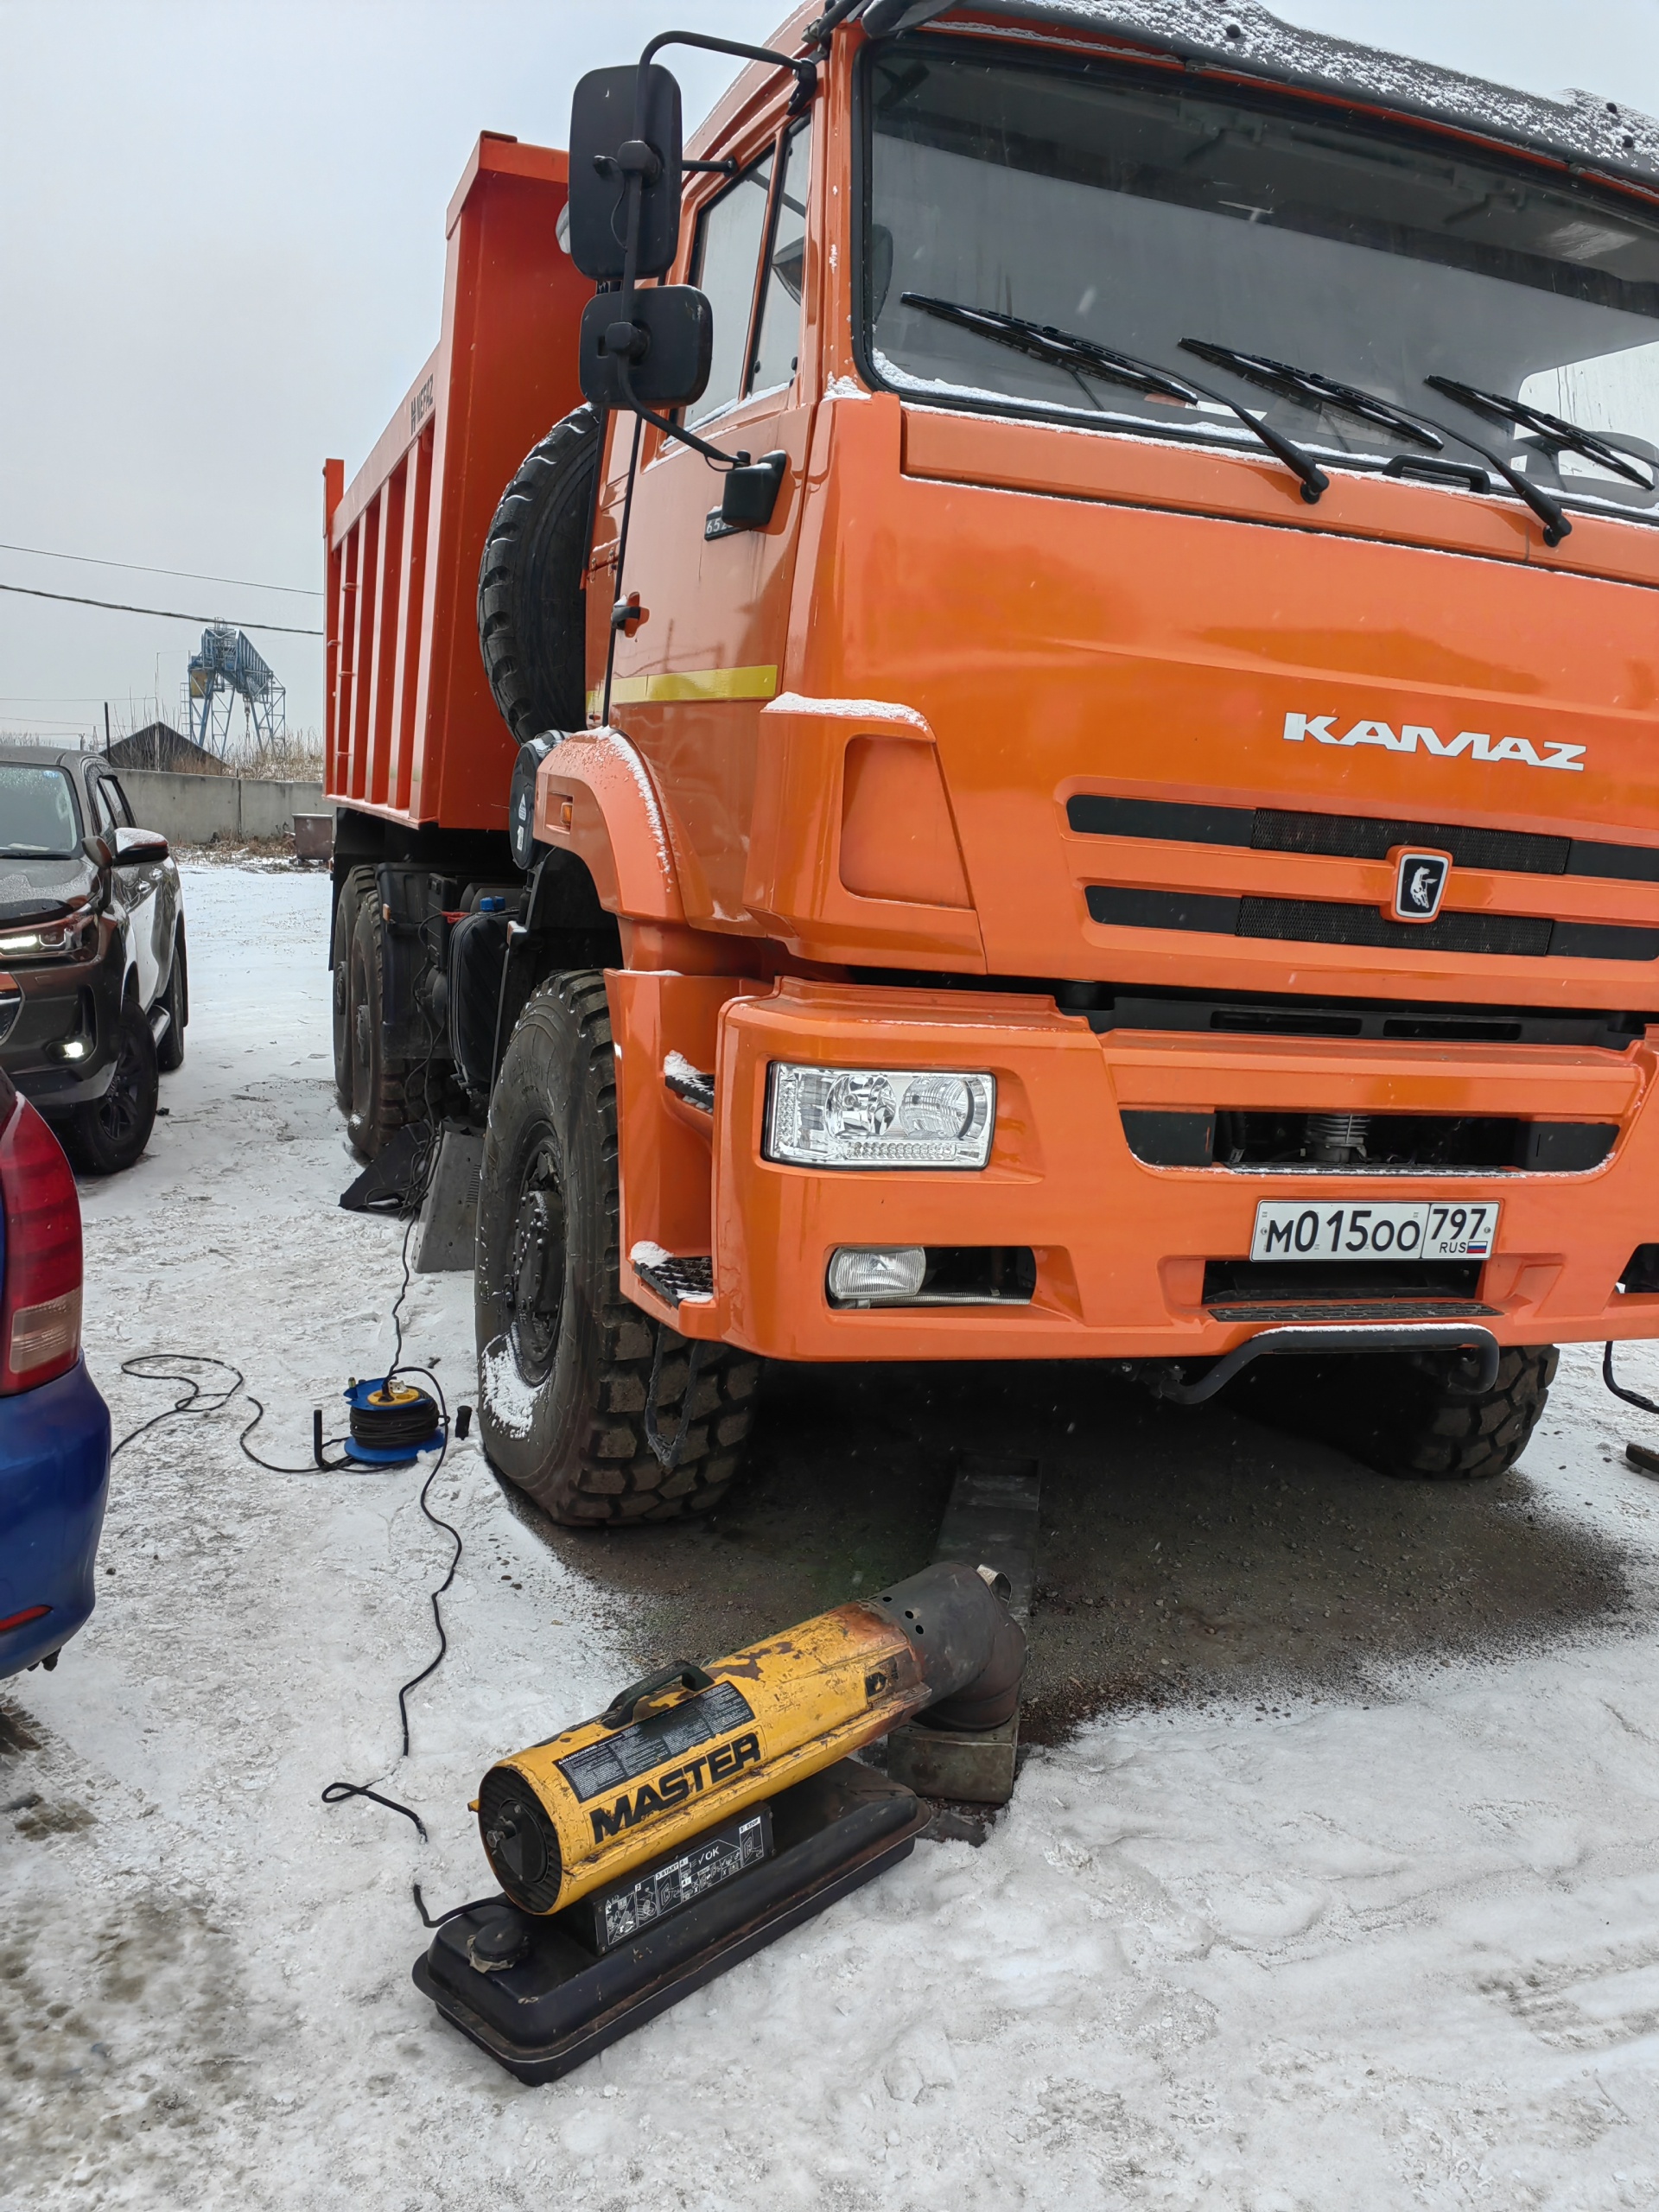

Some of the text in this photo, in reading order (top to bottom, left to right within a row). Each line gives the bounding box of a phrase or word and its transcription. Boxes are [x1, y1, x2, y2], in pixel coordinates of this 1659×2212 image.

[1283, 711, 1586, 772] KAMAZ
[1431, 1208, 1487, 1240] 797
[1439, 1242, 1466, 1254] RUS
[589, 1732, 761, 1845] MASTER
[705, 1846, 719, 1860] OK
[661, 1864, 678, 1878] START
